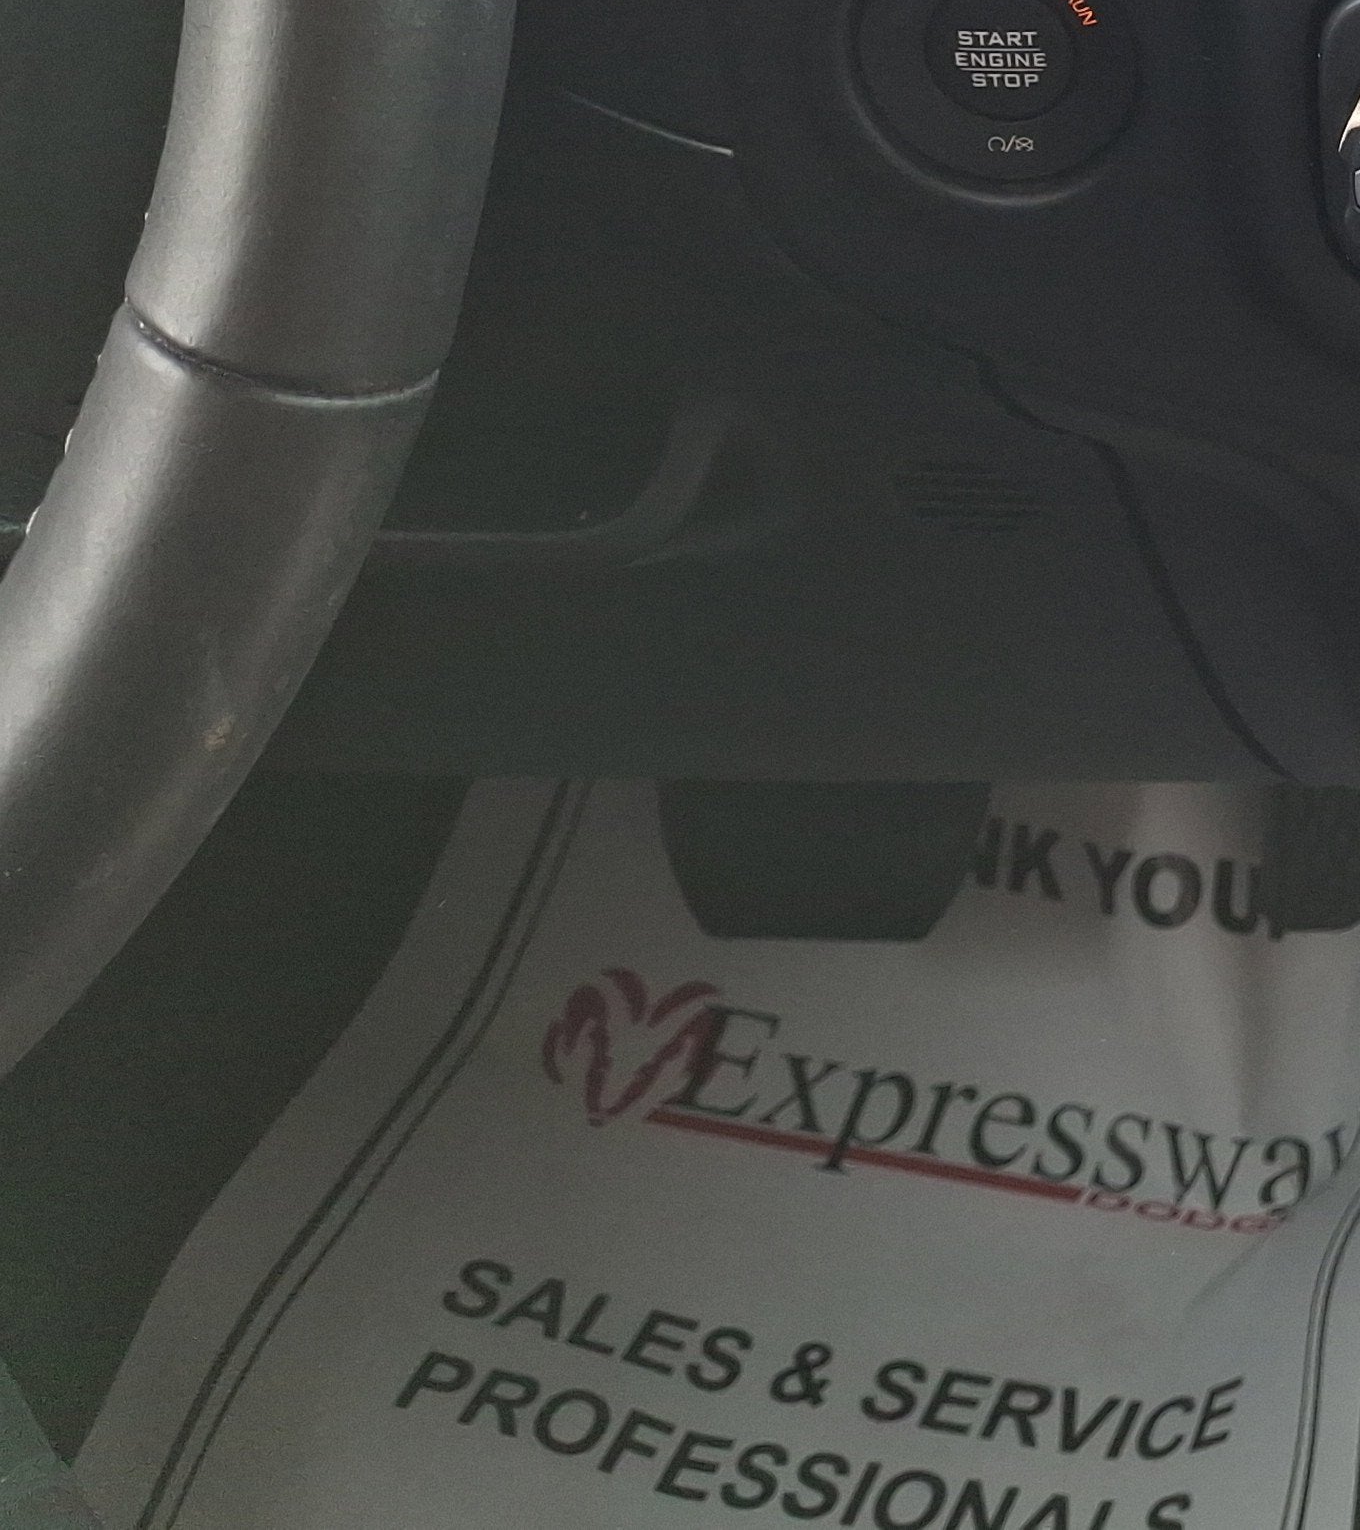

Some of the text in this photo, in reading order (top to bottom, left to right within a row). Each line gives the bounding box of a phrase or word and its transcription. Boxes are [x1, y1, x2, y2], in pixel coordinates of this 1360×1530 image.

[957, 29, 1038, 47] START
[954, 51, 1048, 68] ENGINE
[971, 72, 1040, 88] STOP
[1081, 841, 1286, 942] YOU
[441, 1257, 1245, 1462] SALES & SERVICE
